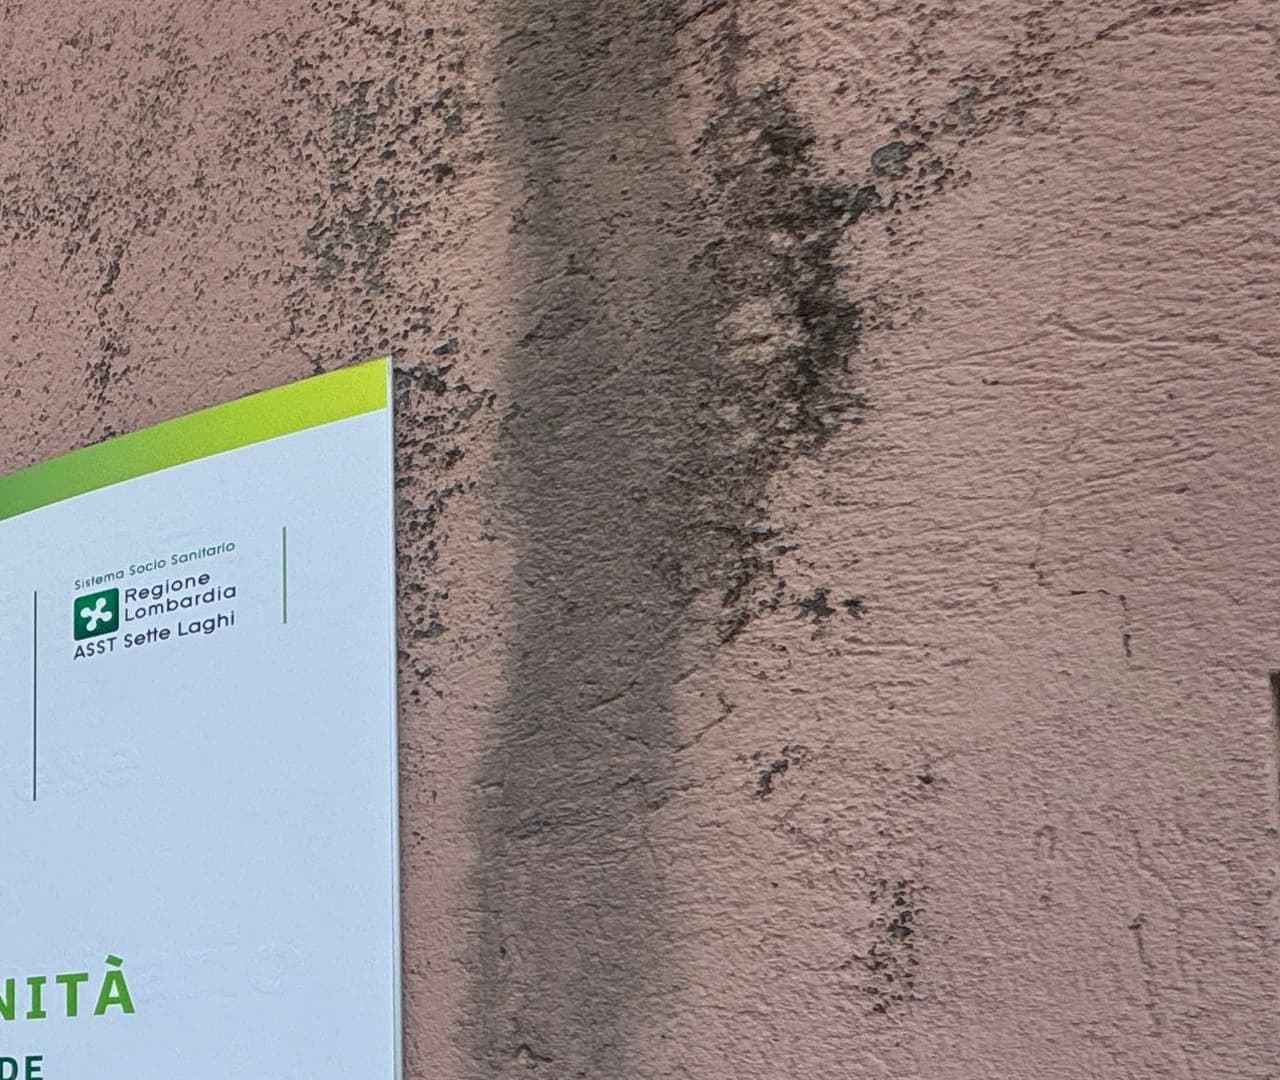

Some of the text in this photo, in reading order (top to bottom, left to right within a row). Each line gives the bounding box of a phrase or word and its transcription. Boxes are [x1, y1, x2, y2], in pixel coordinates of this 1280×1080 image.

[74, 541, 236, 591] Sistema Socio Sanitario
[124, 573, 210, 603] Regione
[124, 586, 237, 622] Lombardia
[73, 610, 236, 660] ASST Sette Laghi
